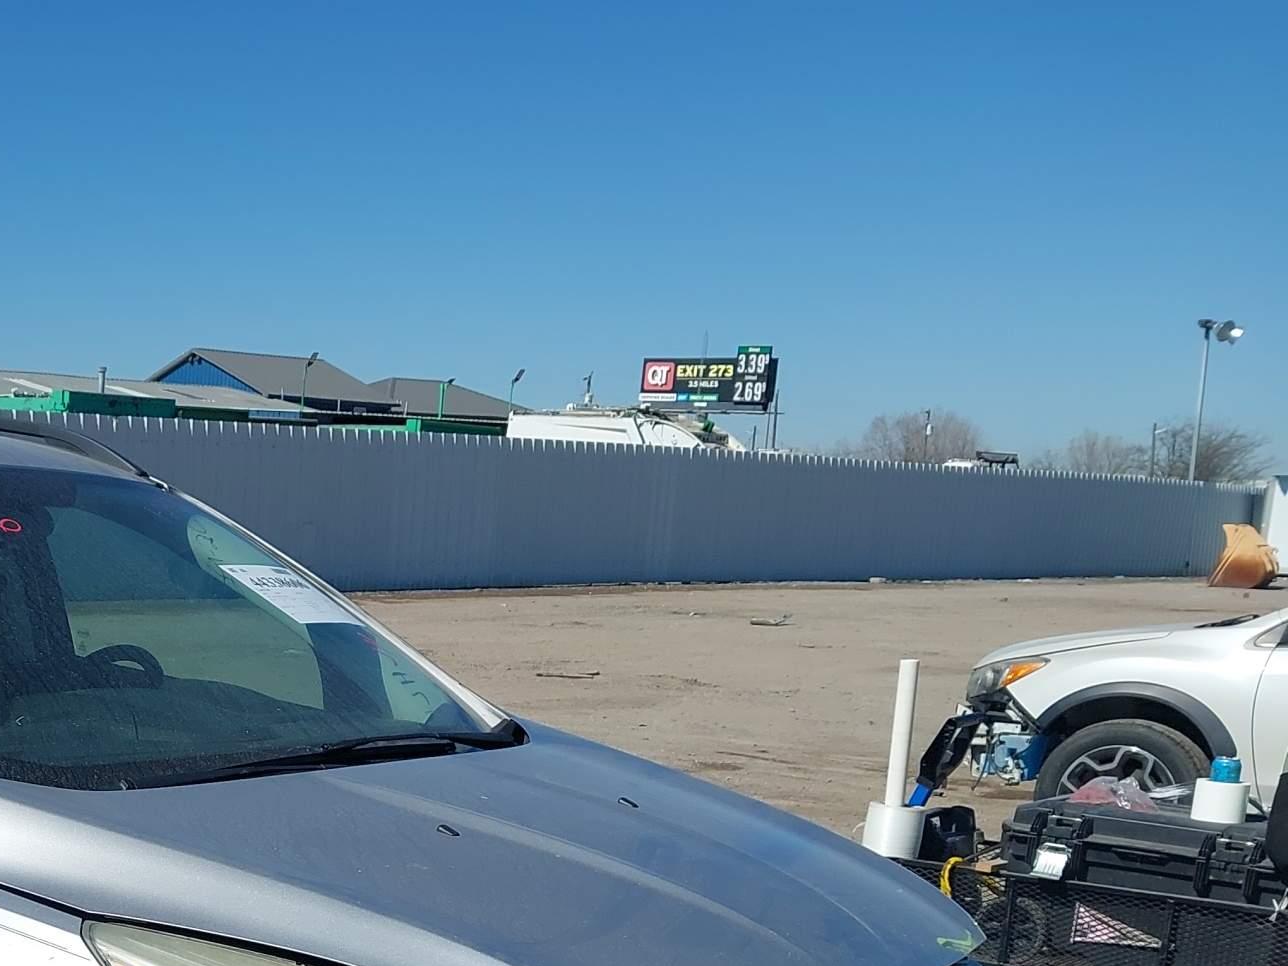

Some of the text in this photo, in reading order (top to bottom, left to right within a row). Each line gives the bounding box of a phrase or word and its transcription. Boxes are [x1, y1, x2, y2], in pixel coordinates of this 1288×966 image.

[647, 364, 670, 387] QT
[676, 364, 734, 377] EXIT 273
